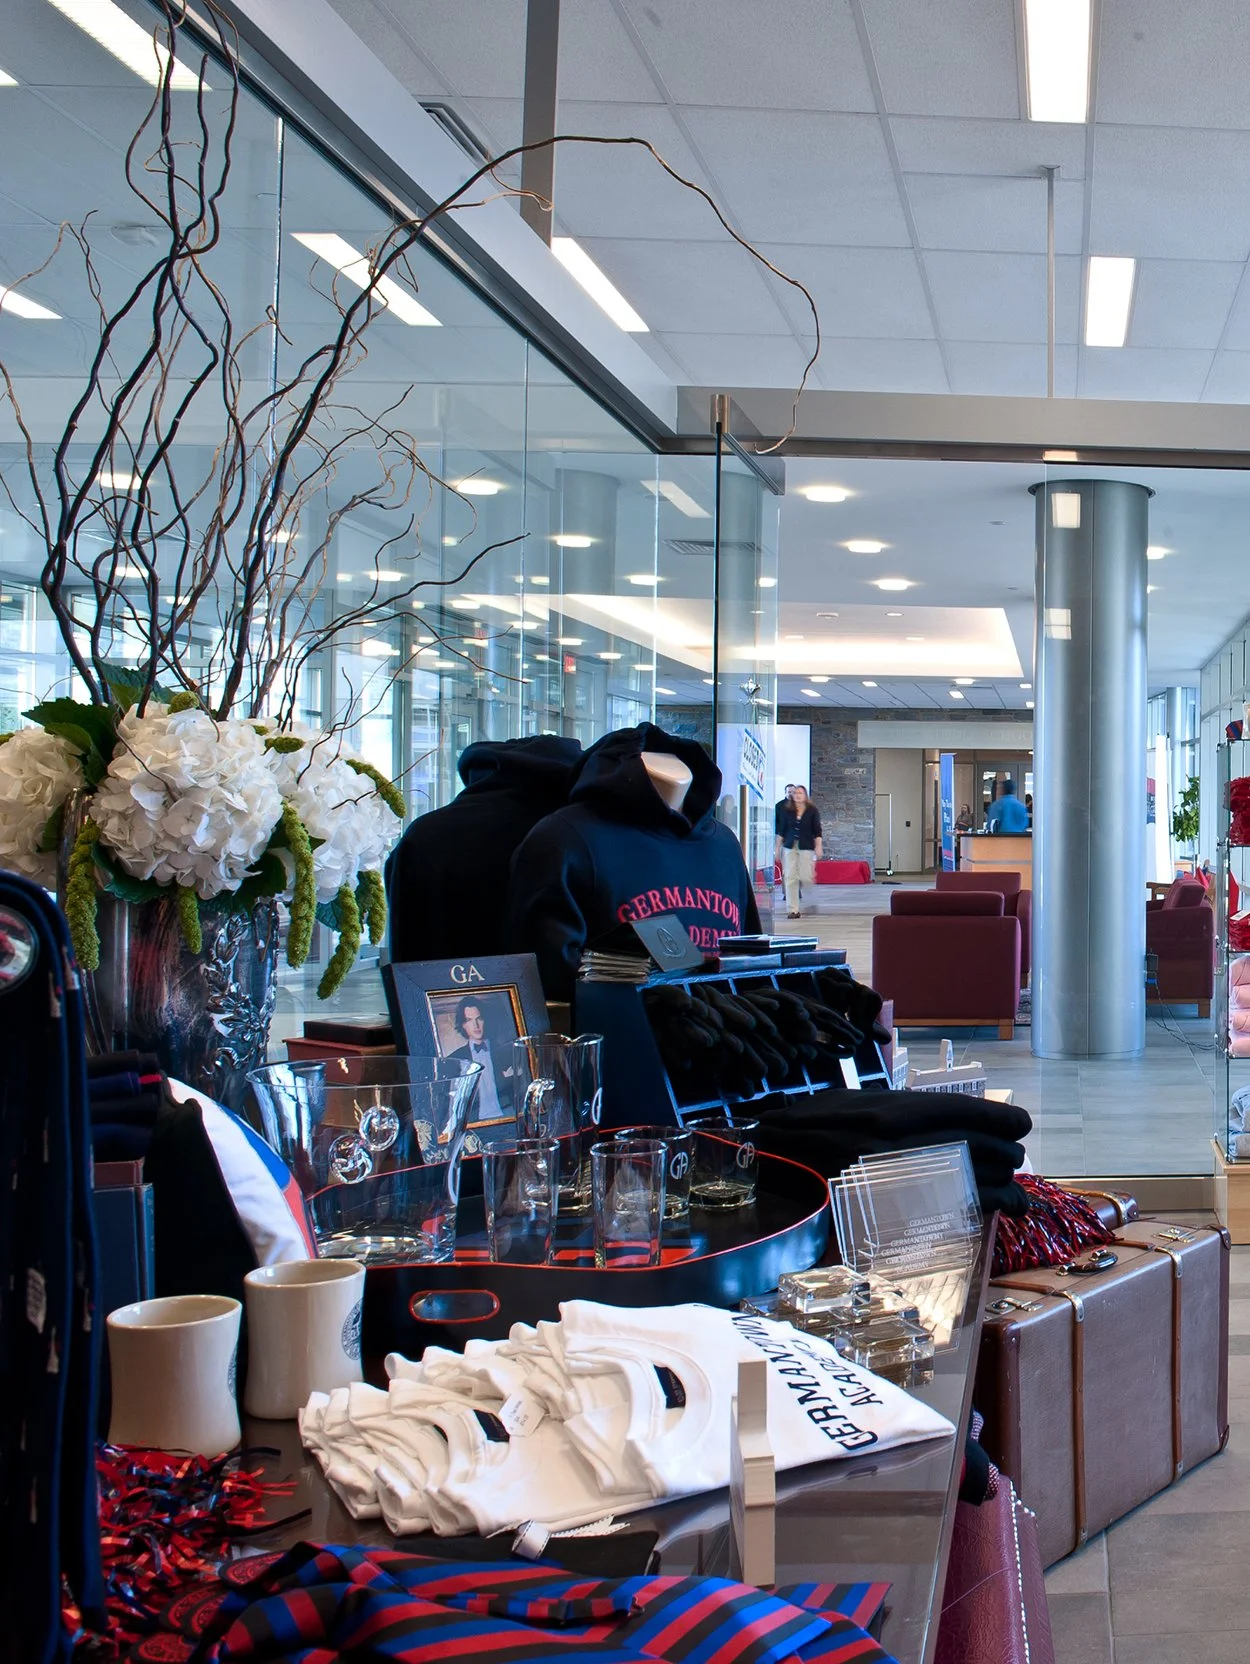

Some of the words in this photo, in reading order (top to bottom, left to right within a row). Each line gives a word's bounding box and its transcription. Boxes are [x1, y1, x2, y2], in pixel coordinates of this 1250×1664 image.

[617, 886, 741, 929] GERMANTOW
[450, 964, 486, 984] GA
[670, 1152, 689, 1180] GA
[736, 1142, 755, 1169] GA
